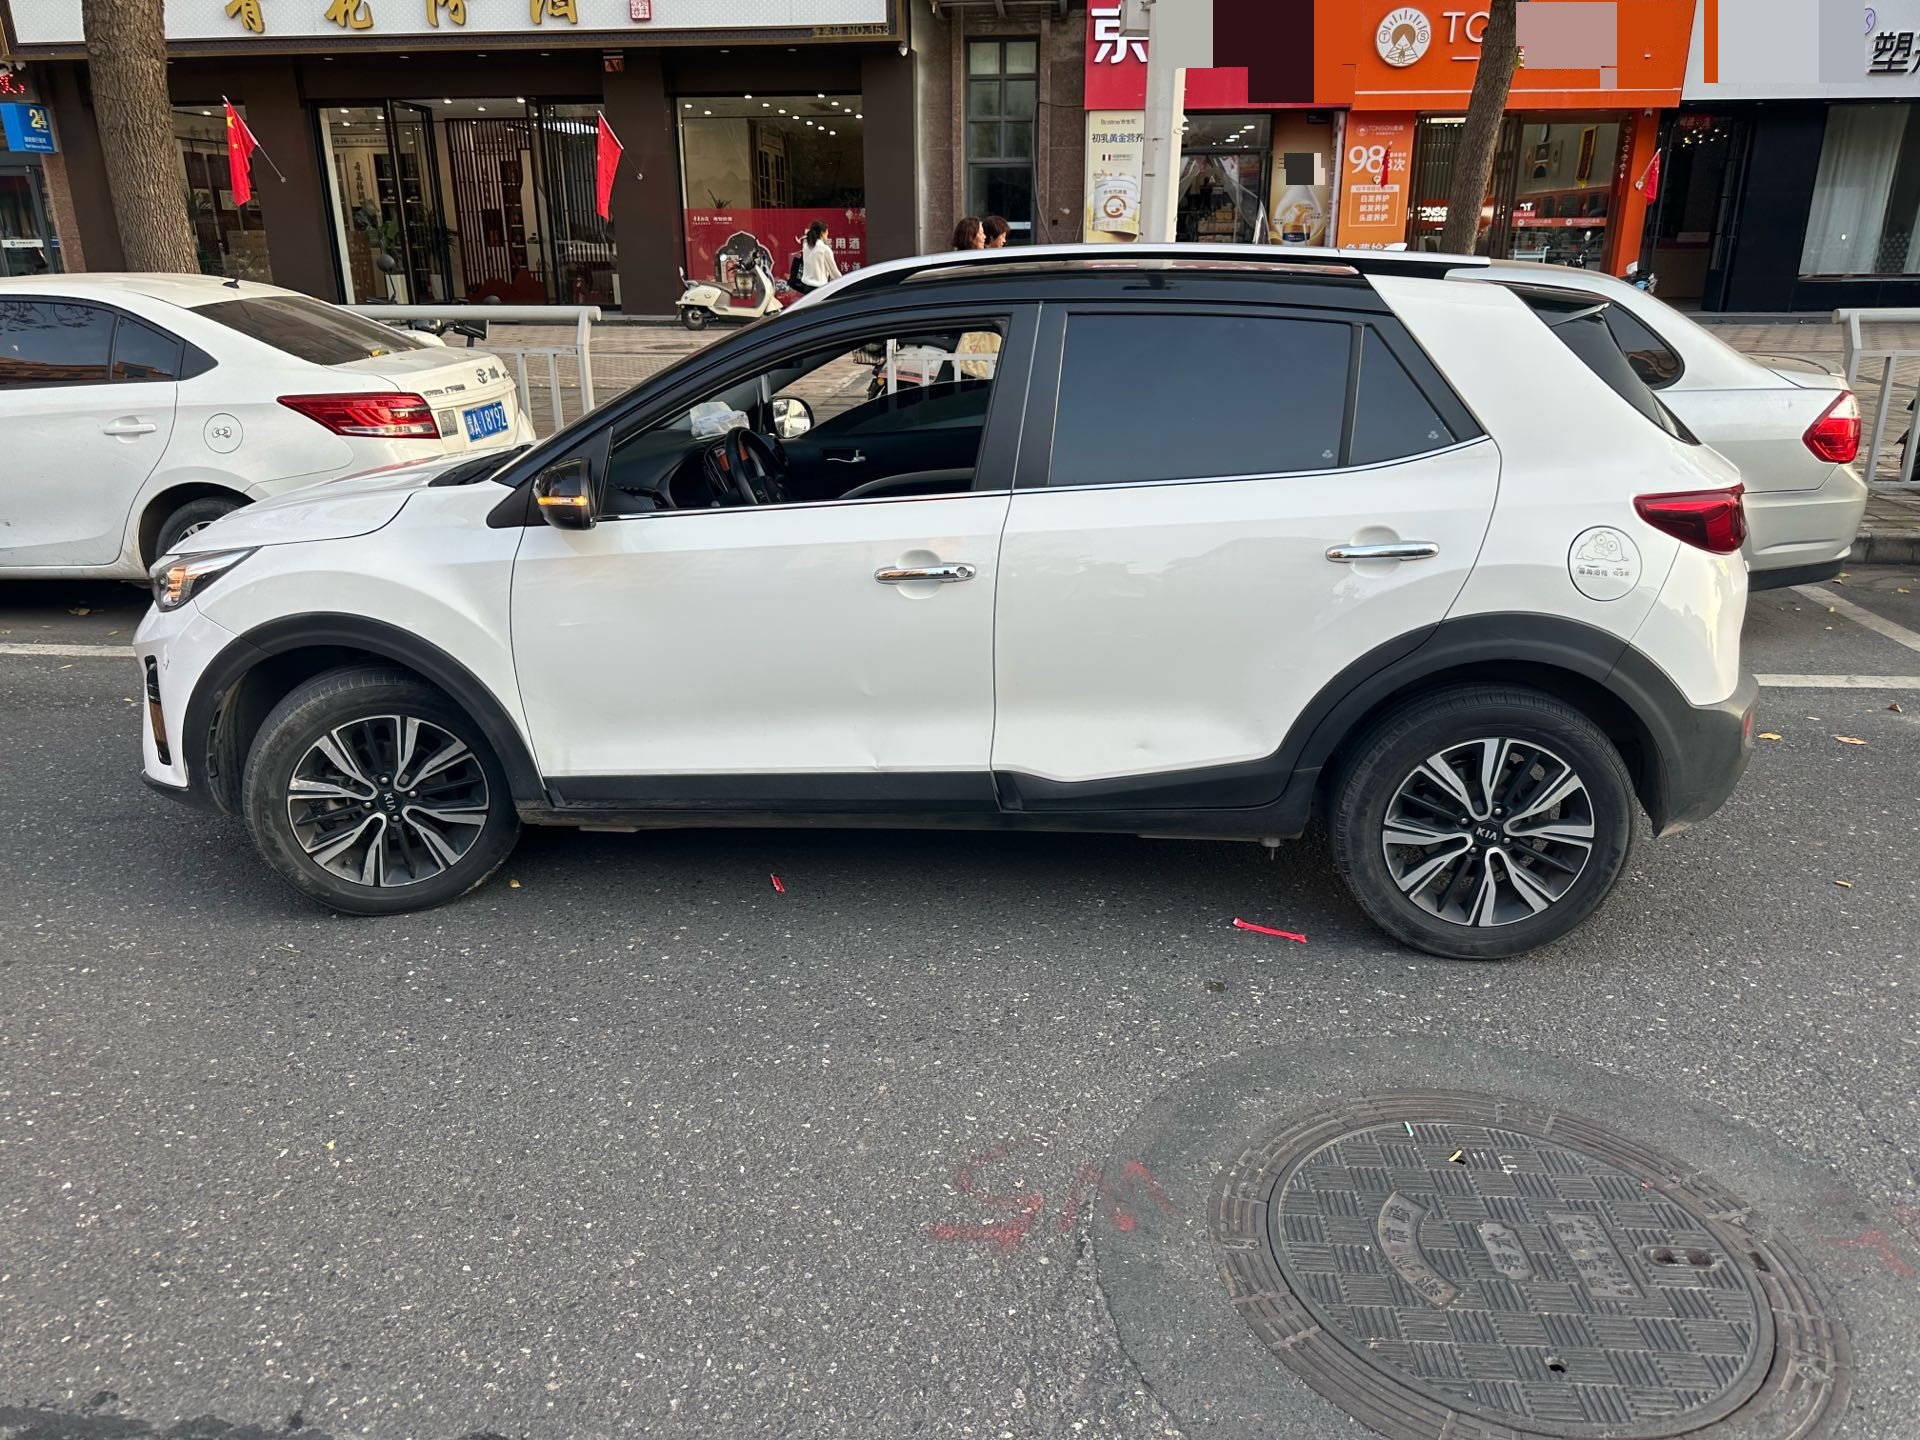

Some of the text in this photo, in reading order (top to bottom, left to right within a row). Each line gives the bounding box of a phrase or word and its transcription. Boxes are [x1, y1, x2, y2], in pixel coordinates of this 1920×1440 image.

[29, 108, 47, 129] 24
[1349, 145, 1385, 174] 98
[1475, 826, 1497, 841] KIA
